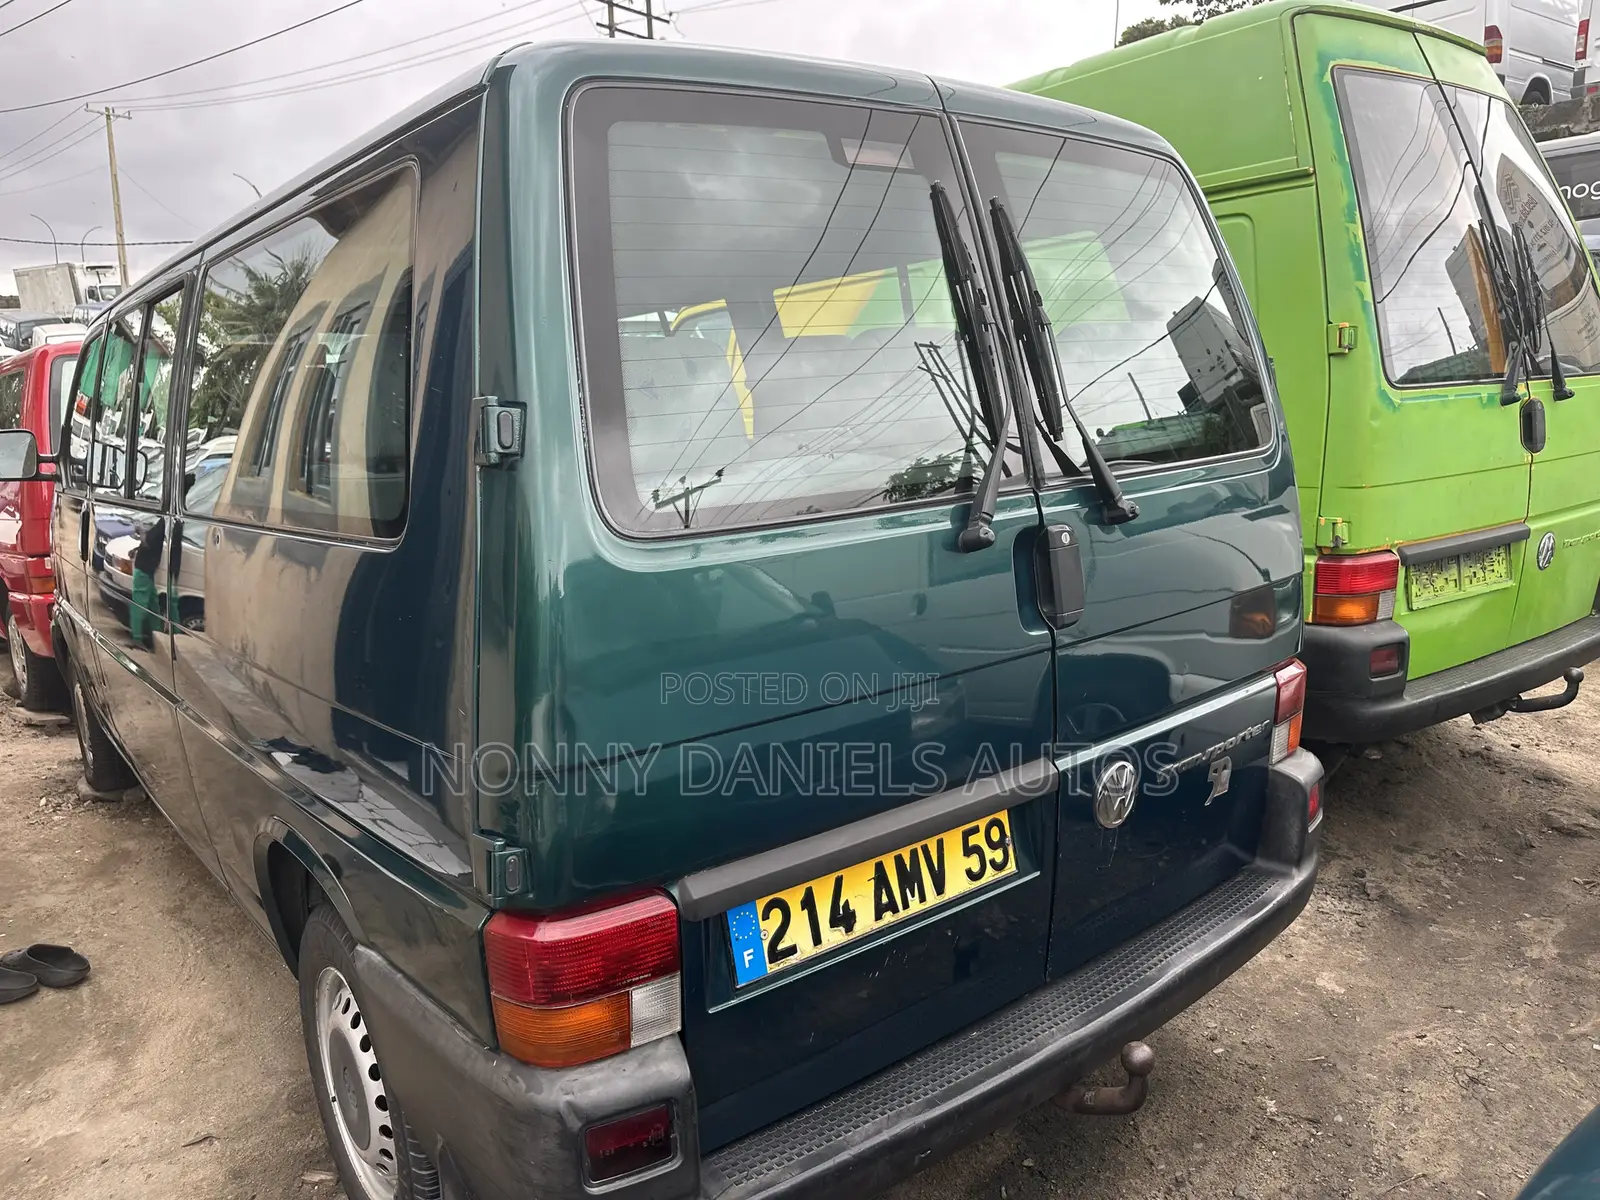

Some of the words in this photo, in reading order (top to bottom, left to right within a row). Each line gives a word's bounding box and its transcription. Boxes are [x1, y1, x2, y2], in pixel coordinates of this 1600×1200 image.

[761, 874, 857, 964] 214
[873, 837, 946, 922] AMV
[961, 816, 1010, 882] 59
[743, 949, 754, 968] F
